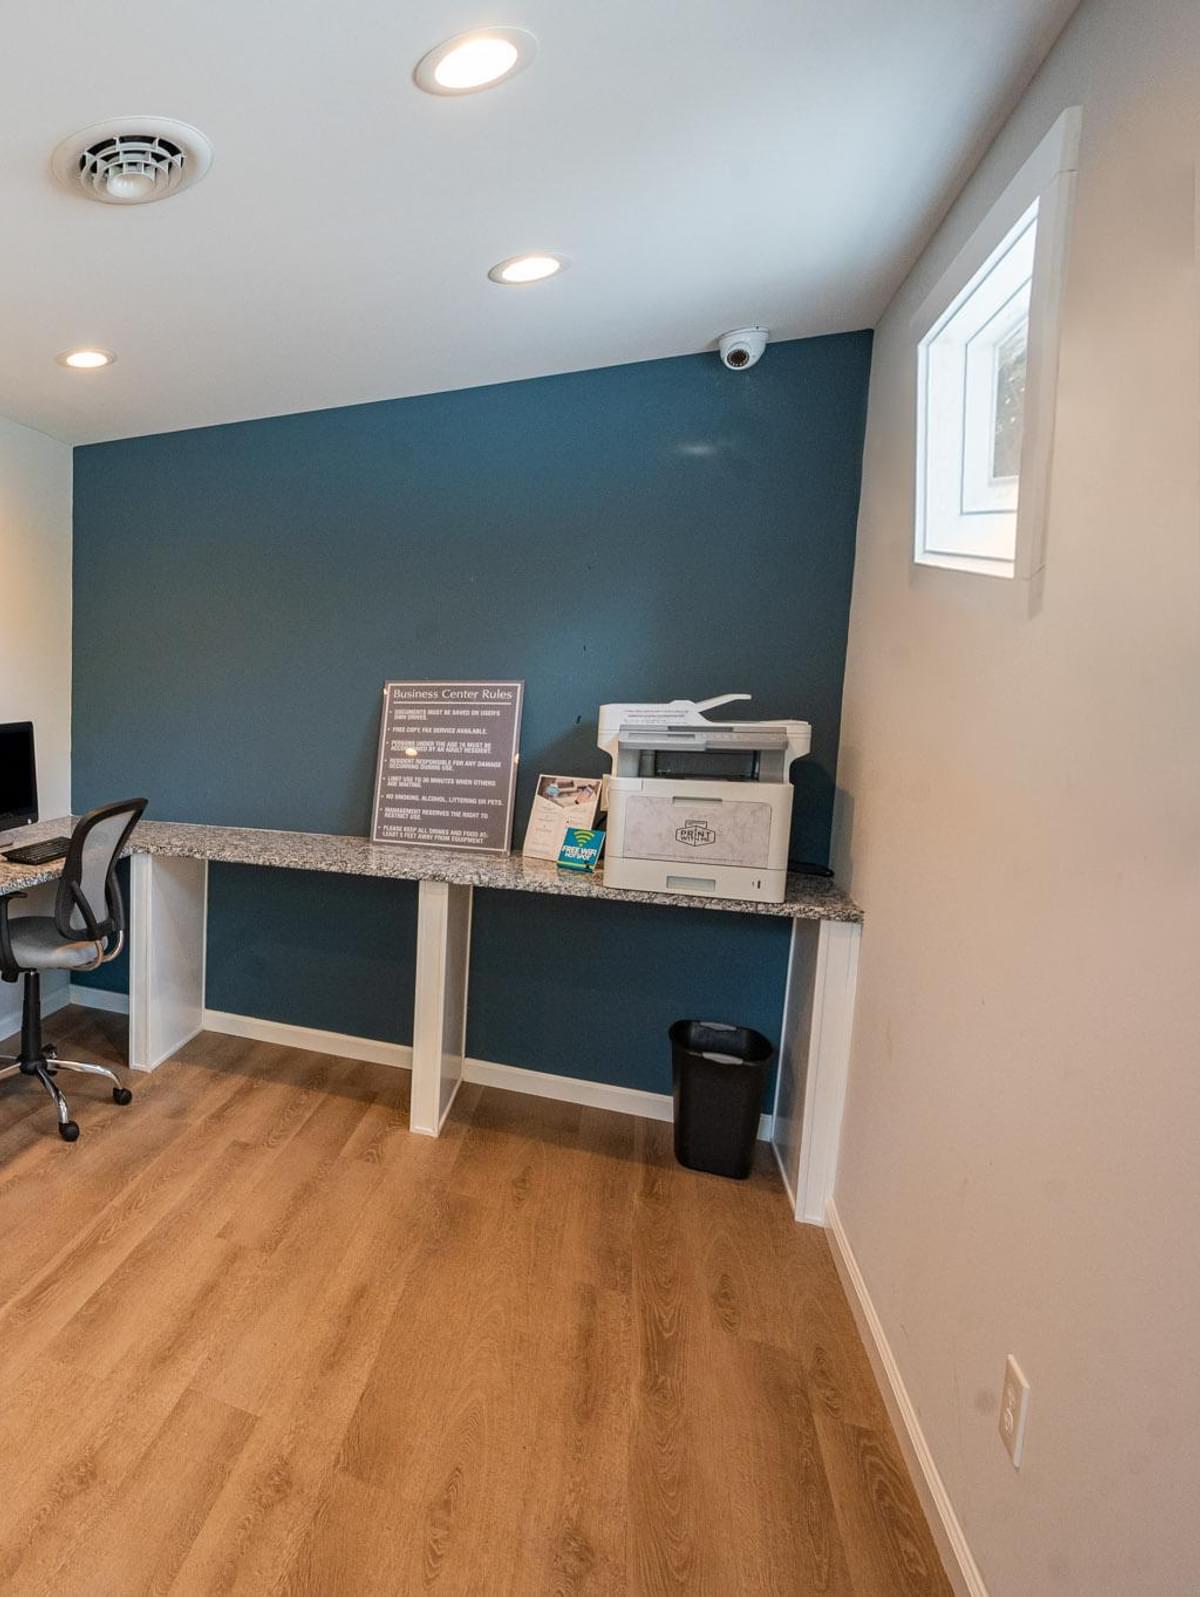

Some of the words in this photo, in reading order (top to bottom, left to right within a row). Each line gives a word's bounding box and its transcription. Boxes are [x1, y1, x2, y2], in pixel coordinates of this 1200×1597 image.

[393, 688, 438, 700] Business
[442, 688, 479, 700] Center
[482, 688, 513, 700] Rules
[422, 809, 450, 817] RESERVES
